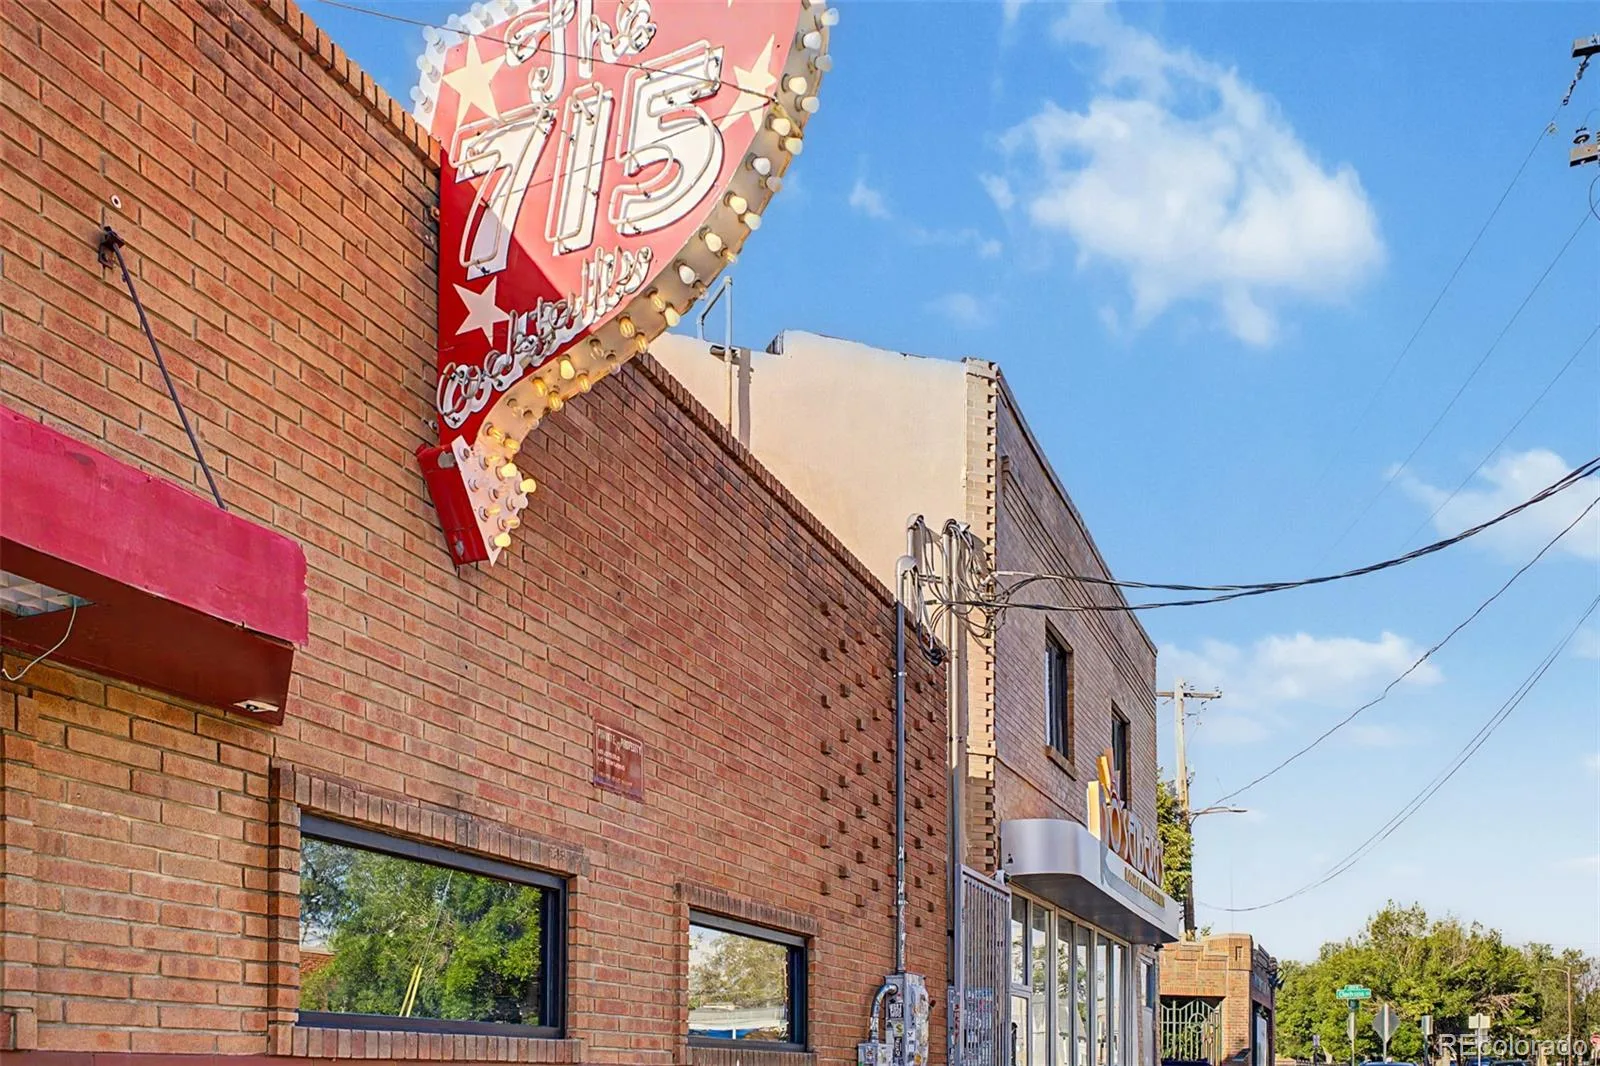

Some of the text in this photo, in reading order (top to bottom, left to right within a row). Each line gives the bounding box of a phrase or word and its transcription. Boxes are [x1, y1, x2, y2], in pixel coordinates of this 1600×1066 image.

[504, 0, 657, 103] The
[450, 40, 725, 281] 715
[437, 246, 653, 429] Cocktails
